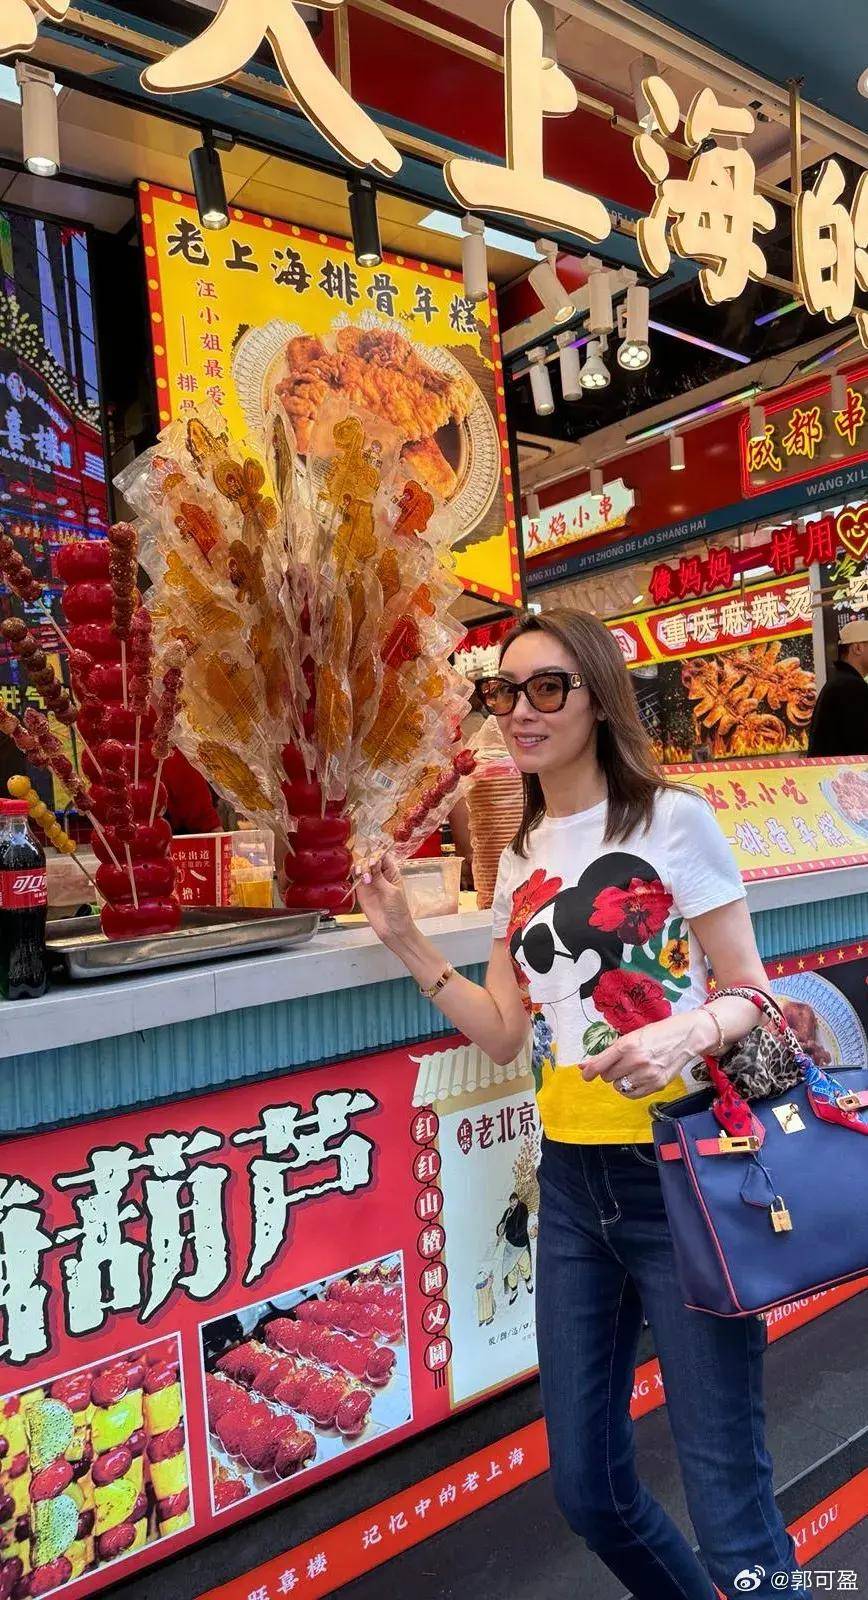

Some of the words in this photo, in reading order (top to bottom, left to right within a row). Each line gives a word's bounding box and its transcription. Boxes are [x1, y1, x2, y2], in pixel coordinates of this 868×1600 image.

[167, 217, 480, 335] 老上海排骨年糕
[196, 279, 226, 406] 汪小姐最爱
[806, 475, 843, 496] WANG
[846, 471, 858, 485] XI
[525, 570, 543, 584] ANG
[552, 563, 568, 576] LOU
[596, 545, 624, 562] ZHONG
[625, 541, 637, 552] DE
[638, 535, 655, 550] LAO
[656, 524, 688, 543] SHANG
[690, 518, 707, 532] HAI
[527, 494, 613, 548] 火焰小串
[662, 585, 814, 645] 重庆麻辣烫
[475, 1101, 536, 1149] 老北京
[361, 1447, 525, 1549] 记忆中的老上海
[811, 1504, 839, 1536] LOU
